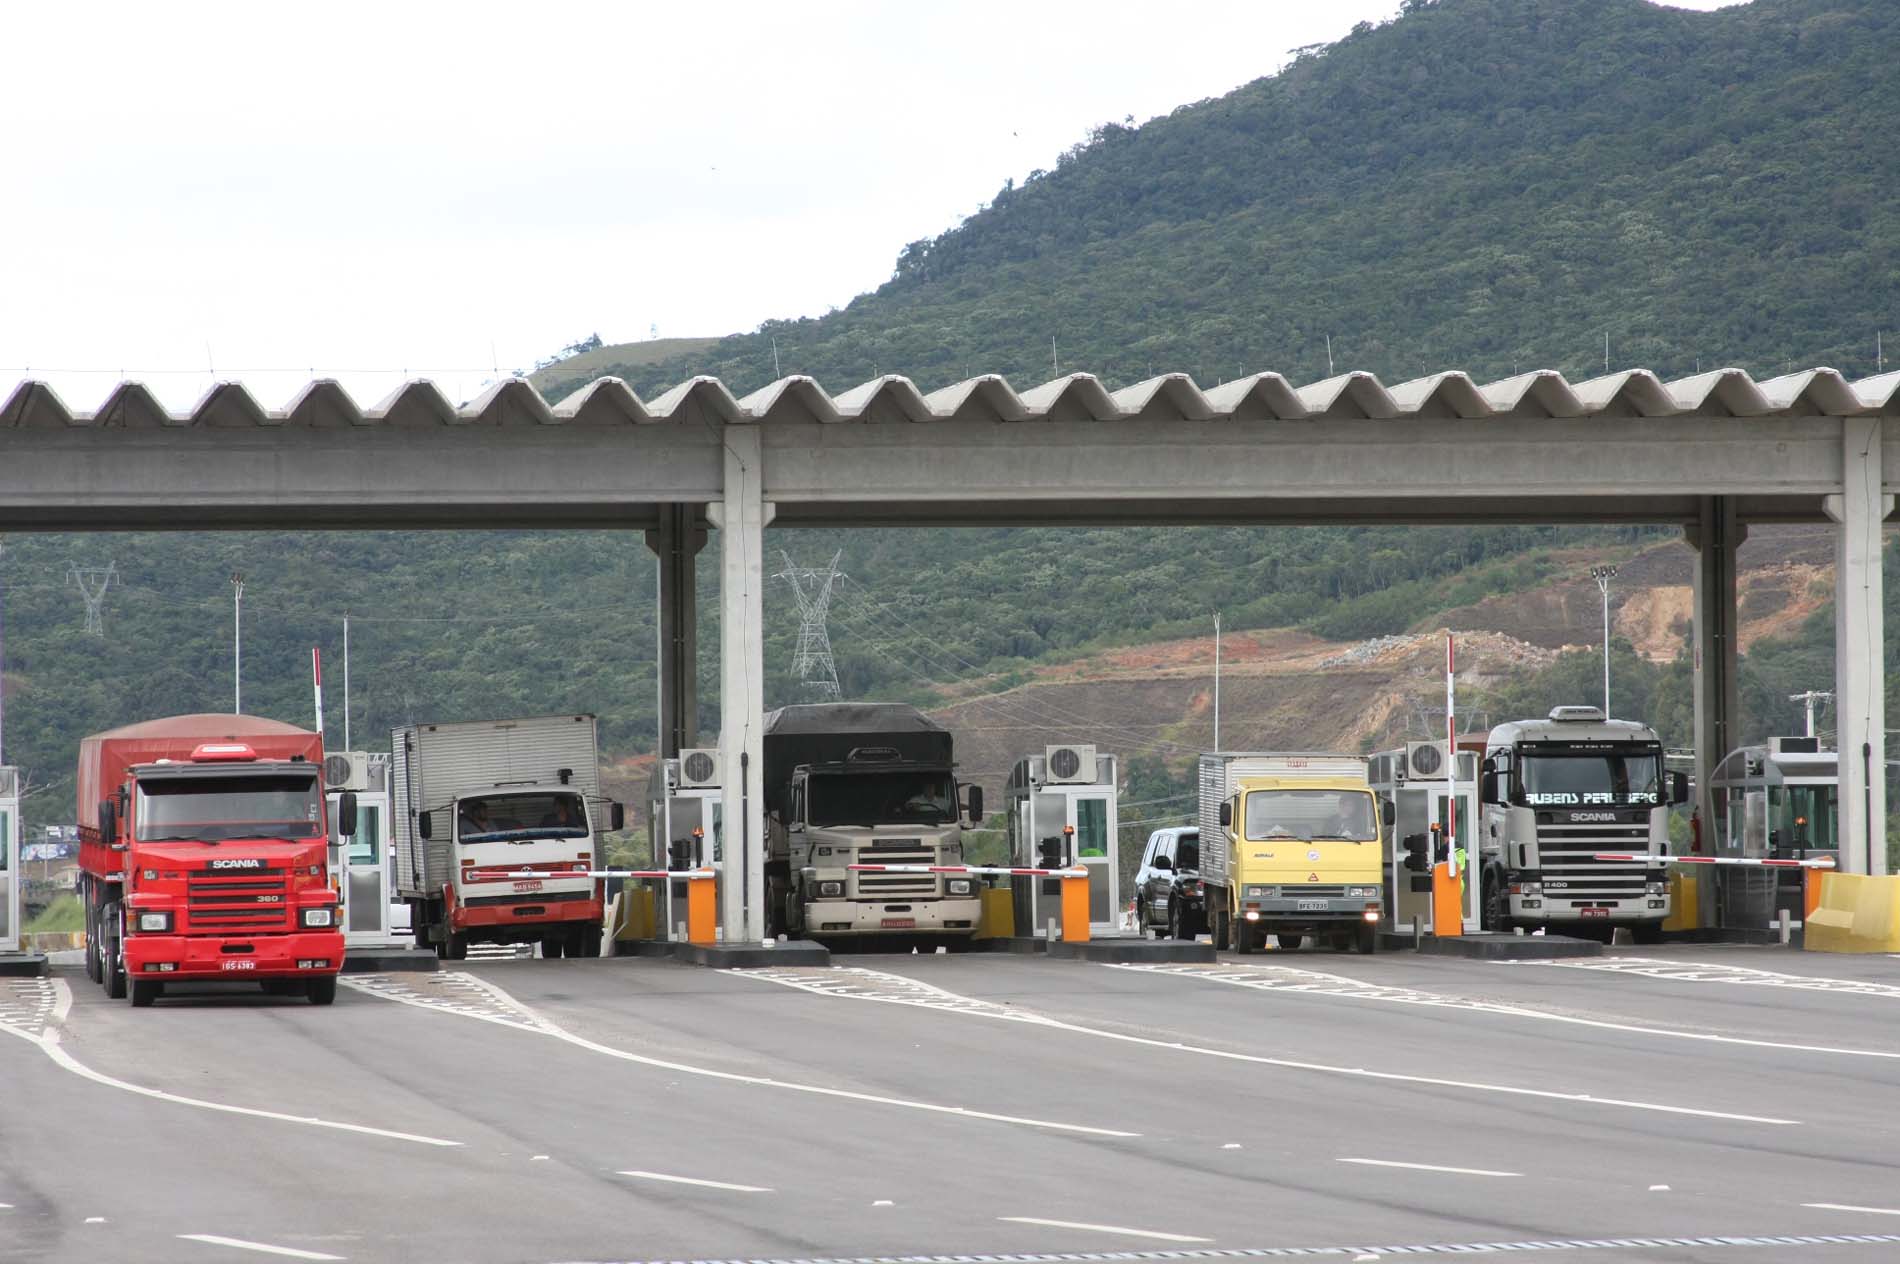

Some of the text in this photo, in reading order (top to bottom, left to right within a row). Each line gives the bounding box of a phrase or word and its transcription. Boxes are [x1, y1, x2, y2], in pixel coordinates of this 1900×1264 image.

[1525, 792, 1579, 805] RUBENS
[1570, 812, 1616, 822] SCANIA
[212, 859, 260, 869] SCANIA
